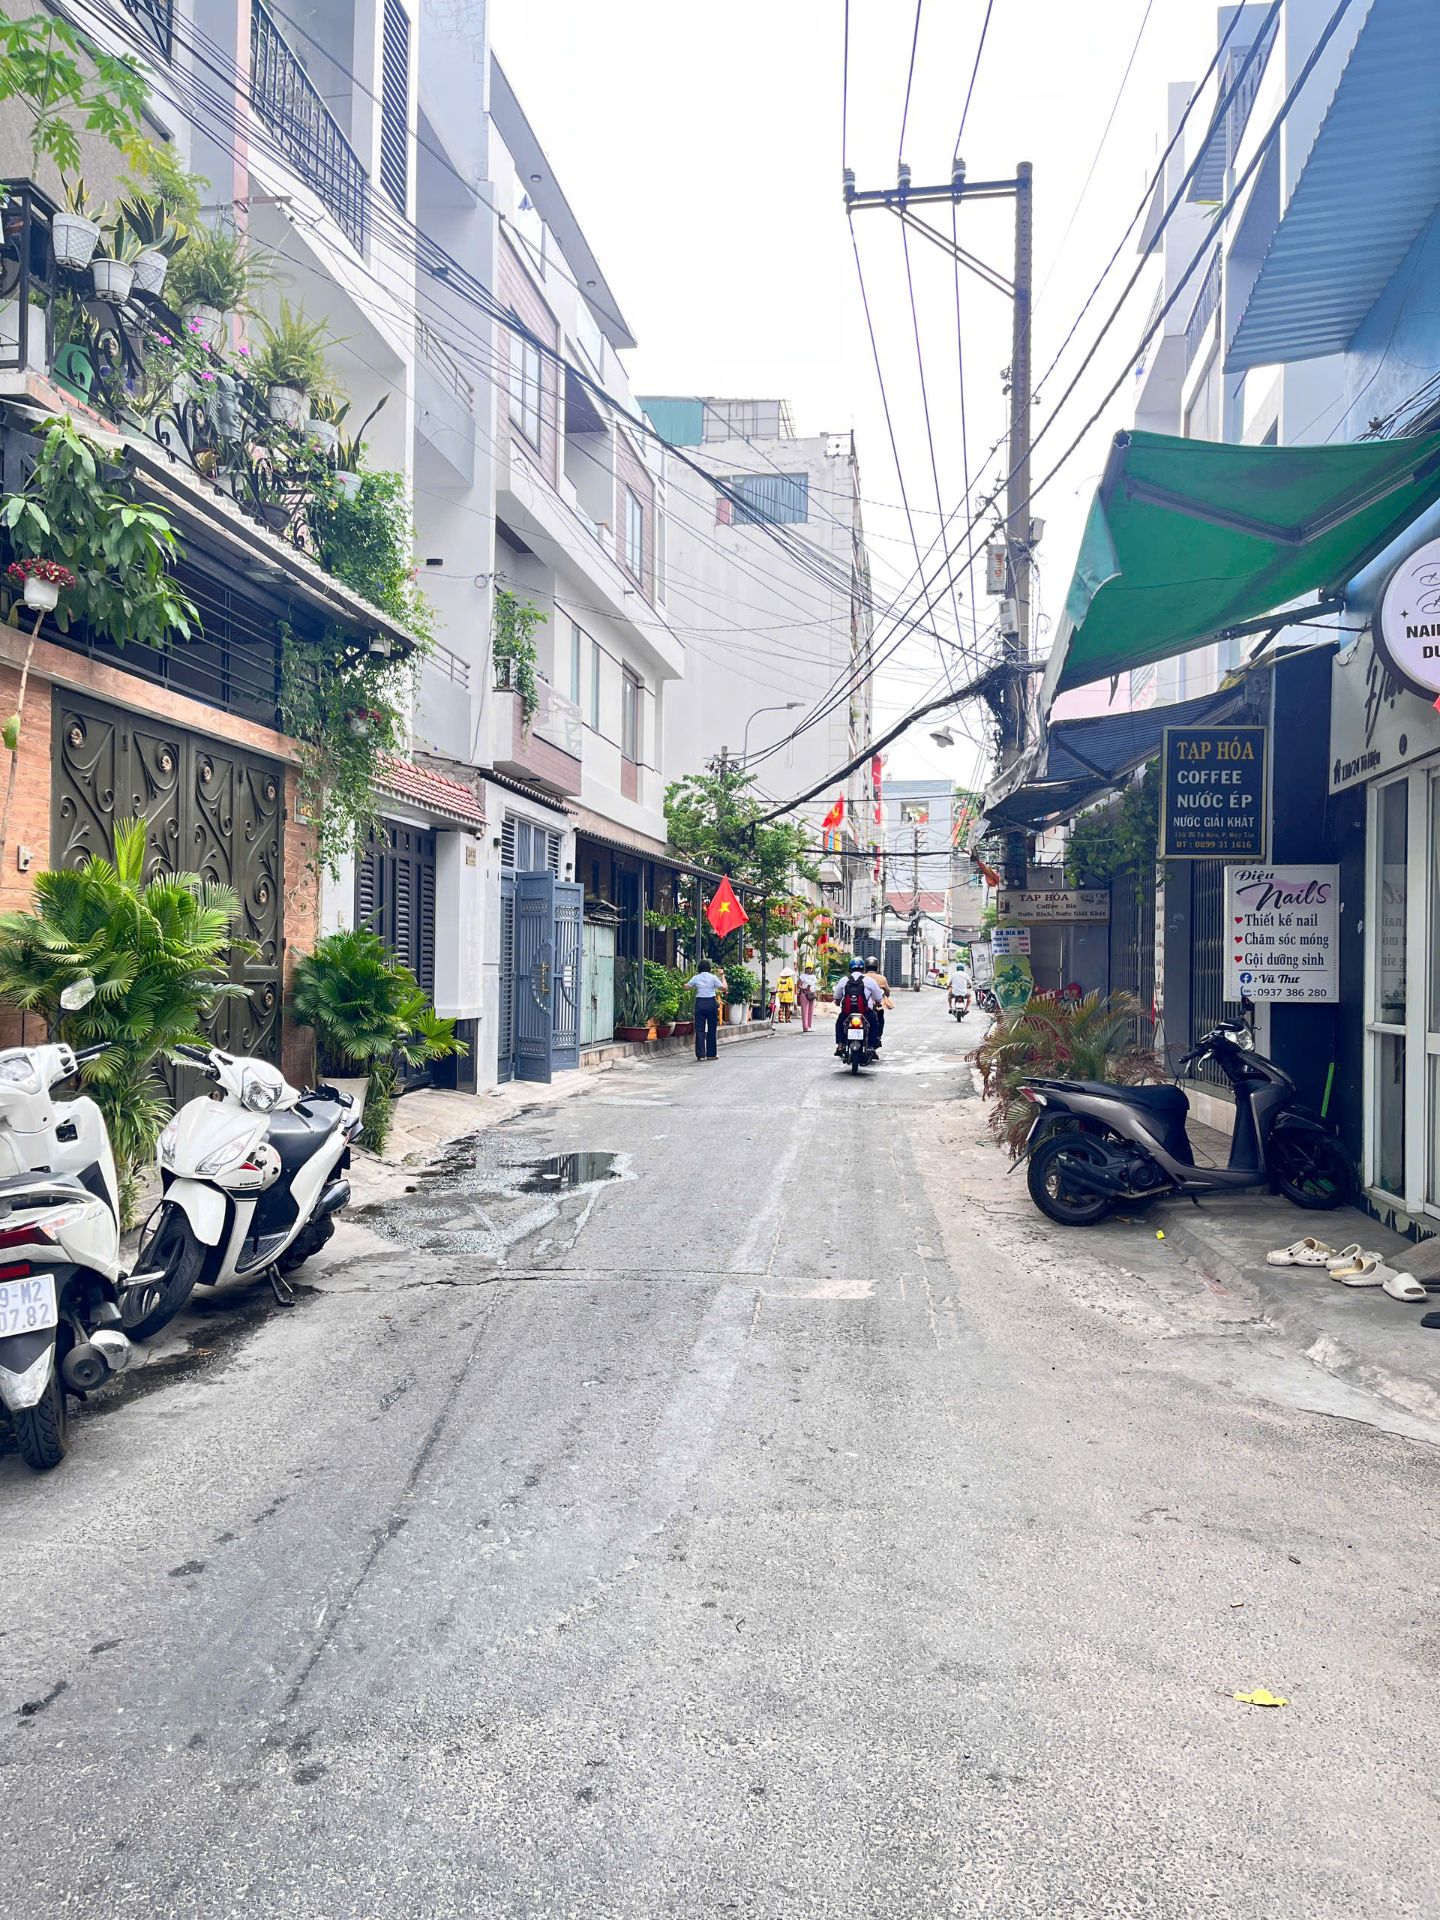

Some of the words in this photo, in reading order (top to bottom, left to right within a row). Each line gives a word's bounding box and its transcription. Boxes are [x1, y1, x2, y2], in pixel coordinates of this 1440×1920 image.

[1177, 741, 1211, 764] TẠP
[1216, 736, 1254, 760] HÓA
[1177, 770, 1242, 784] COFFEE
[1177, 791, 1223, 808] NƯỚC
[1229, 791, 1253, 808] ÉP
[1173, 815, 1200, 827] NƯỚC
[1203, 813, 1224, 827] GIẢI
[1227, 814, 1254, 827] KHÁT
[1019, 894, 1041, 903] TẠP
[1045, 892, 1069, 901] HÓA
[1244, 912, 1274, 926] Thiết
[1278, 912, 1293, 926] kế
[1296, 913, 1318, 926] nail
[1244, 932, 1275, 945] Chăm
[1278, 934, 1296, 945] sóc
[1300, 934, 1329, 949] móng
[1244, 953, 1263, 968] Gội
[1267, 953, 1298, 969] dưỡng
[1302, 953, 1324, 966] sinh
[1286, 988, 1304, 997] 386
[1308, 988, 1327, 997] 280
